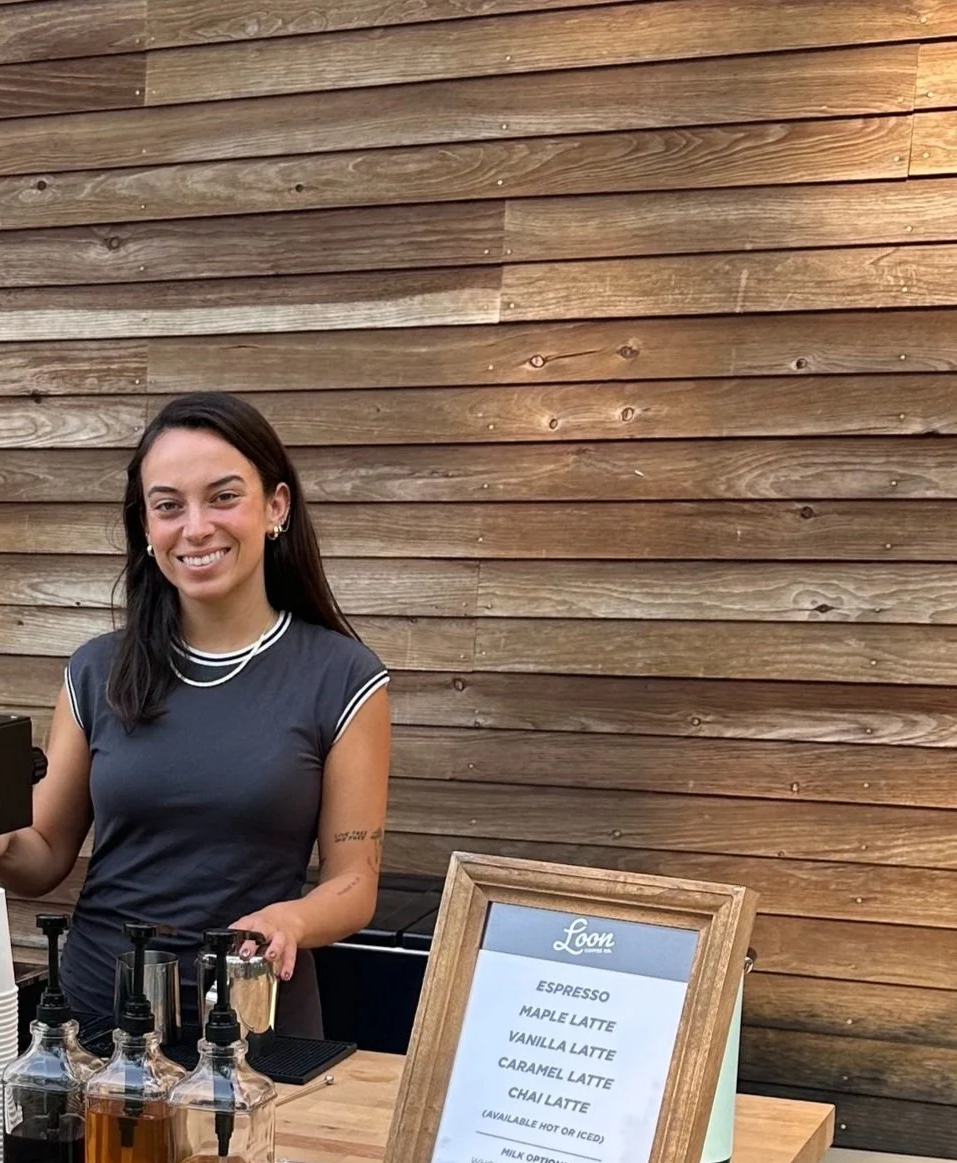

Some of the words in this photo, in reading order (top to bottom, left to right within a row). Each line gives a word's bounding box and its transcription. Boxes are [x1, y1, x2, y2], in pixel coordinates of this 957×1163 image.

[553, 918, 615, 955] Loon
[536, 980, 610, 1002] ESPRESSO
[519, 1005, 569, 1024] MAPLE
[569, 1014, 617, 1032] LATTE
[509, 1030, 567, 1052] VANILLA
[569, 1042, 617, 1061] LATTE
[498, 1057, 564, 1080] CARAMEL
[567, 1071, 615, 1090] LATTE
[508, 1087, 543, 1104] CHAI
[544, 1094, 590, 1113] LATTE
[482, 1110, 538, 1128] (AVAILABLE
[538, 1122, 559, 1133] HOT
[561, 1127, 575, 1137] OR
[577, 1130, 605, 1144] ICED)
[501, 1148, 525, 1160] MILK
